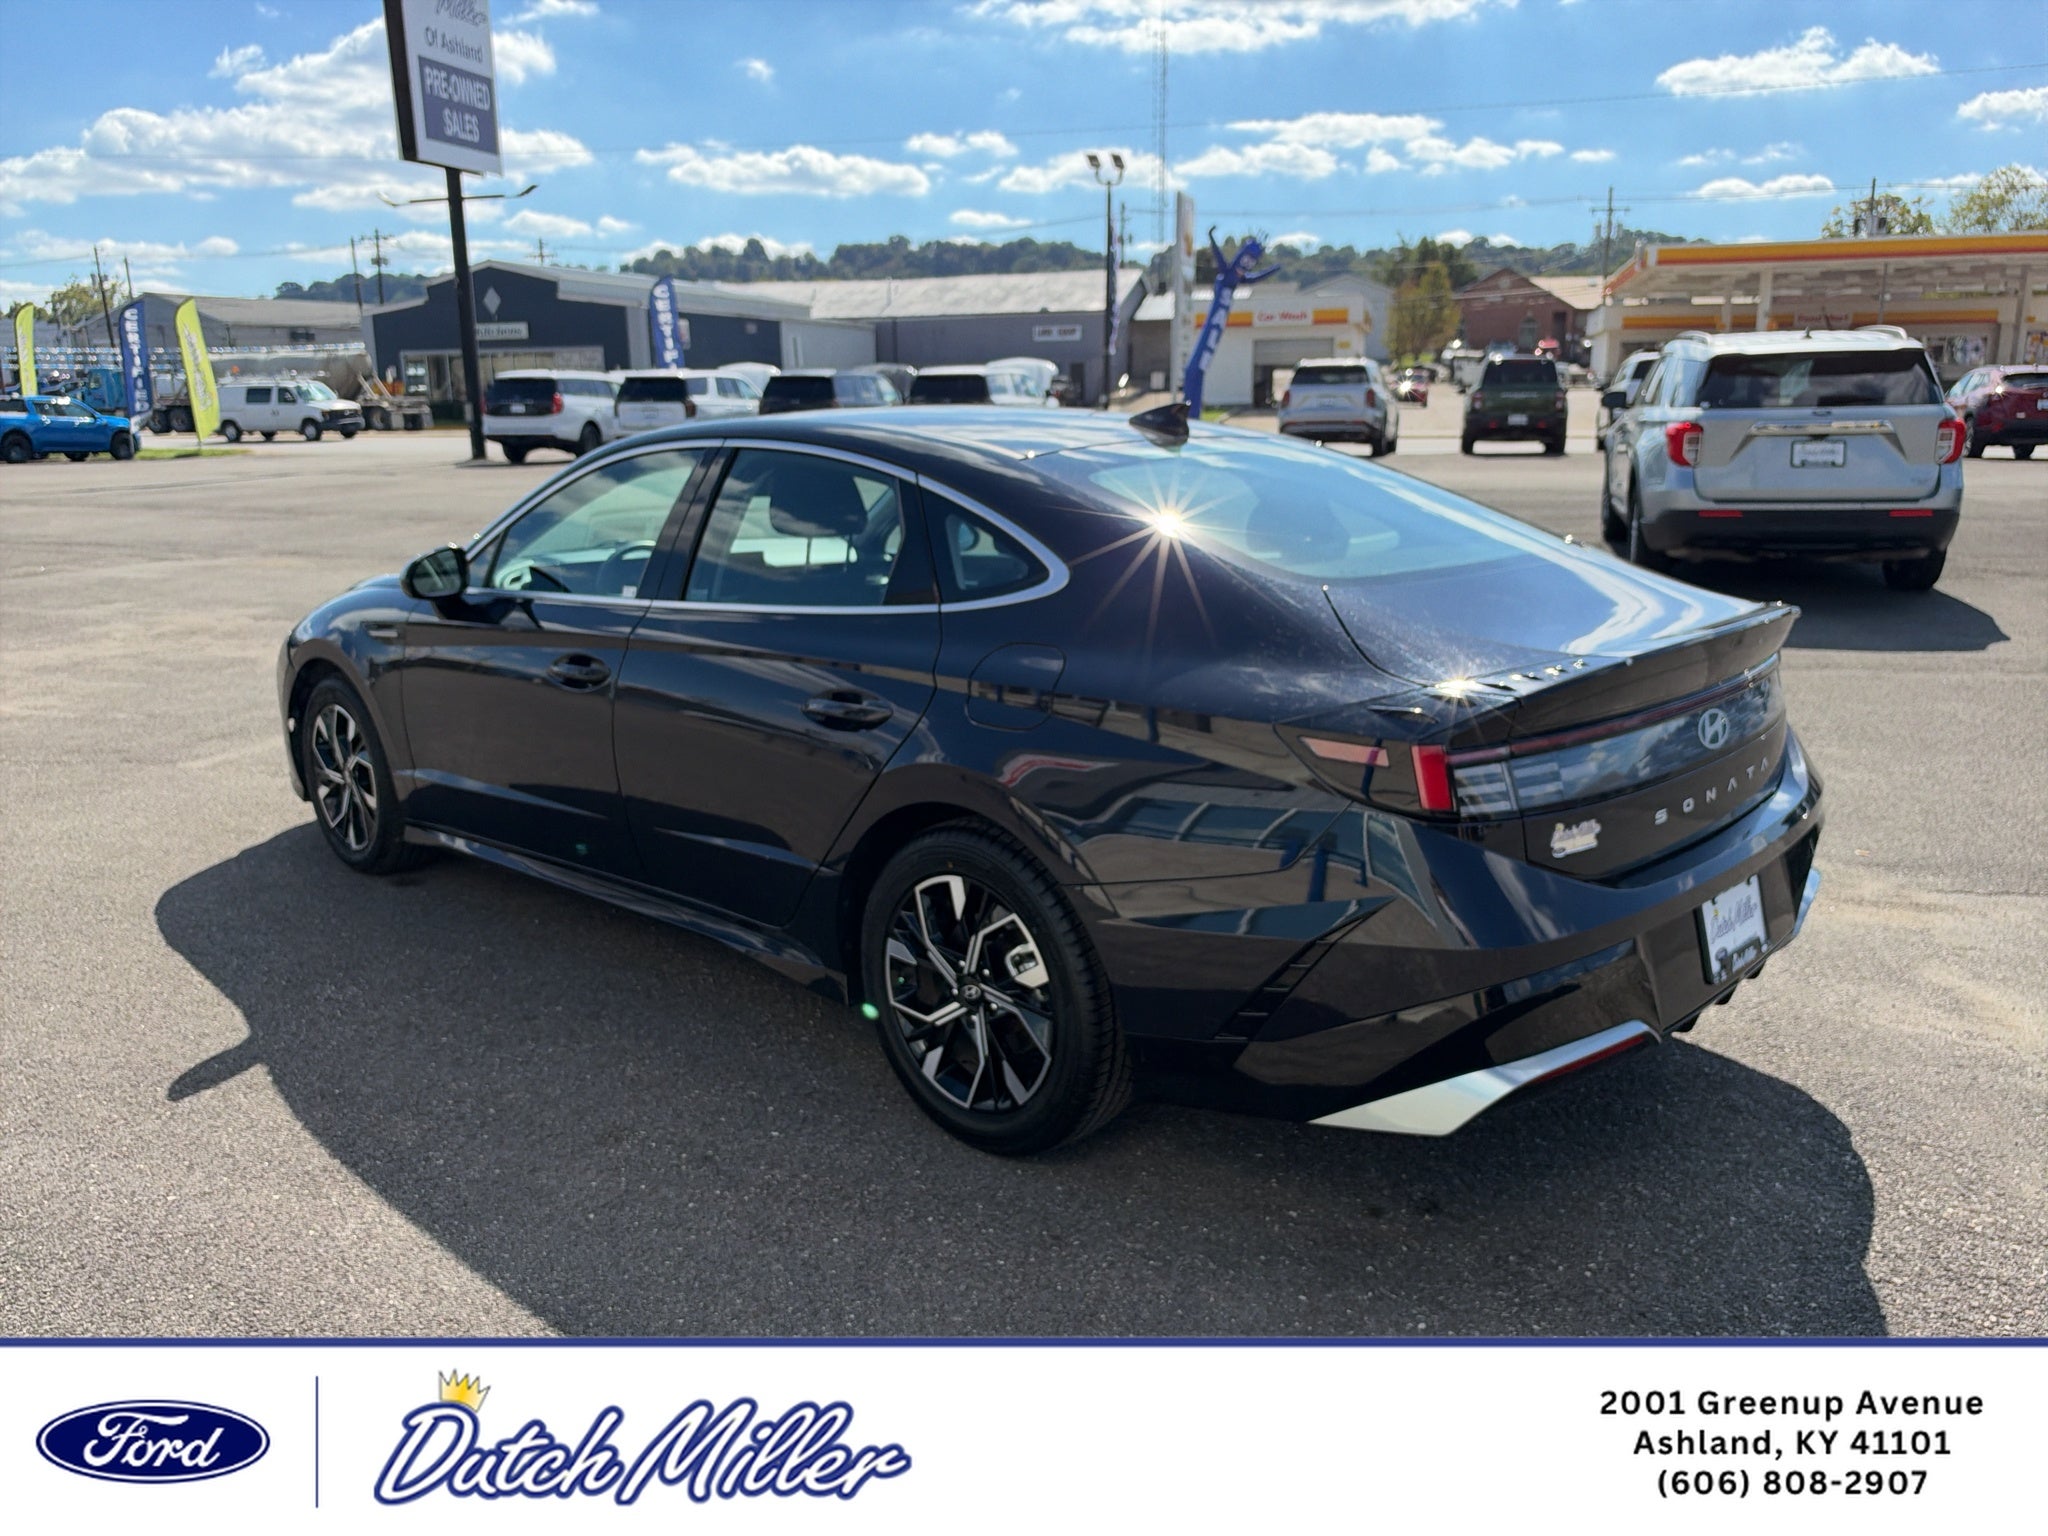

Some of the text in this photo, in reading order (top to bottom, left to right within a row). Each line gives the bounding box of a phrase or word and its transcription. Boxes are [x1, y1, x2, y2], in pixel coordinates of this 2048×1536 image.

[424, 26, 483, 63] Of Ashland
[424, 66, 491, 111] PRE-OWNED
[443, 107, 480, 143] SALES
[124, 308, 150, 413] CERTIFIED
[1654, 757, 1769, 825] SONATA
